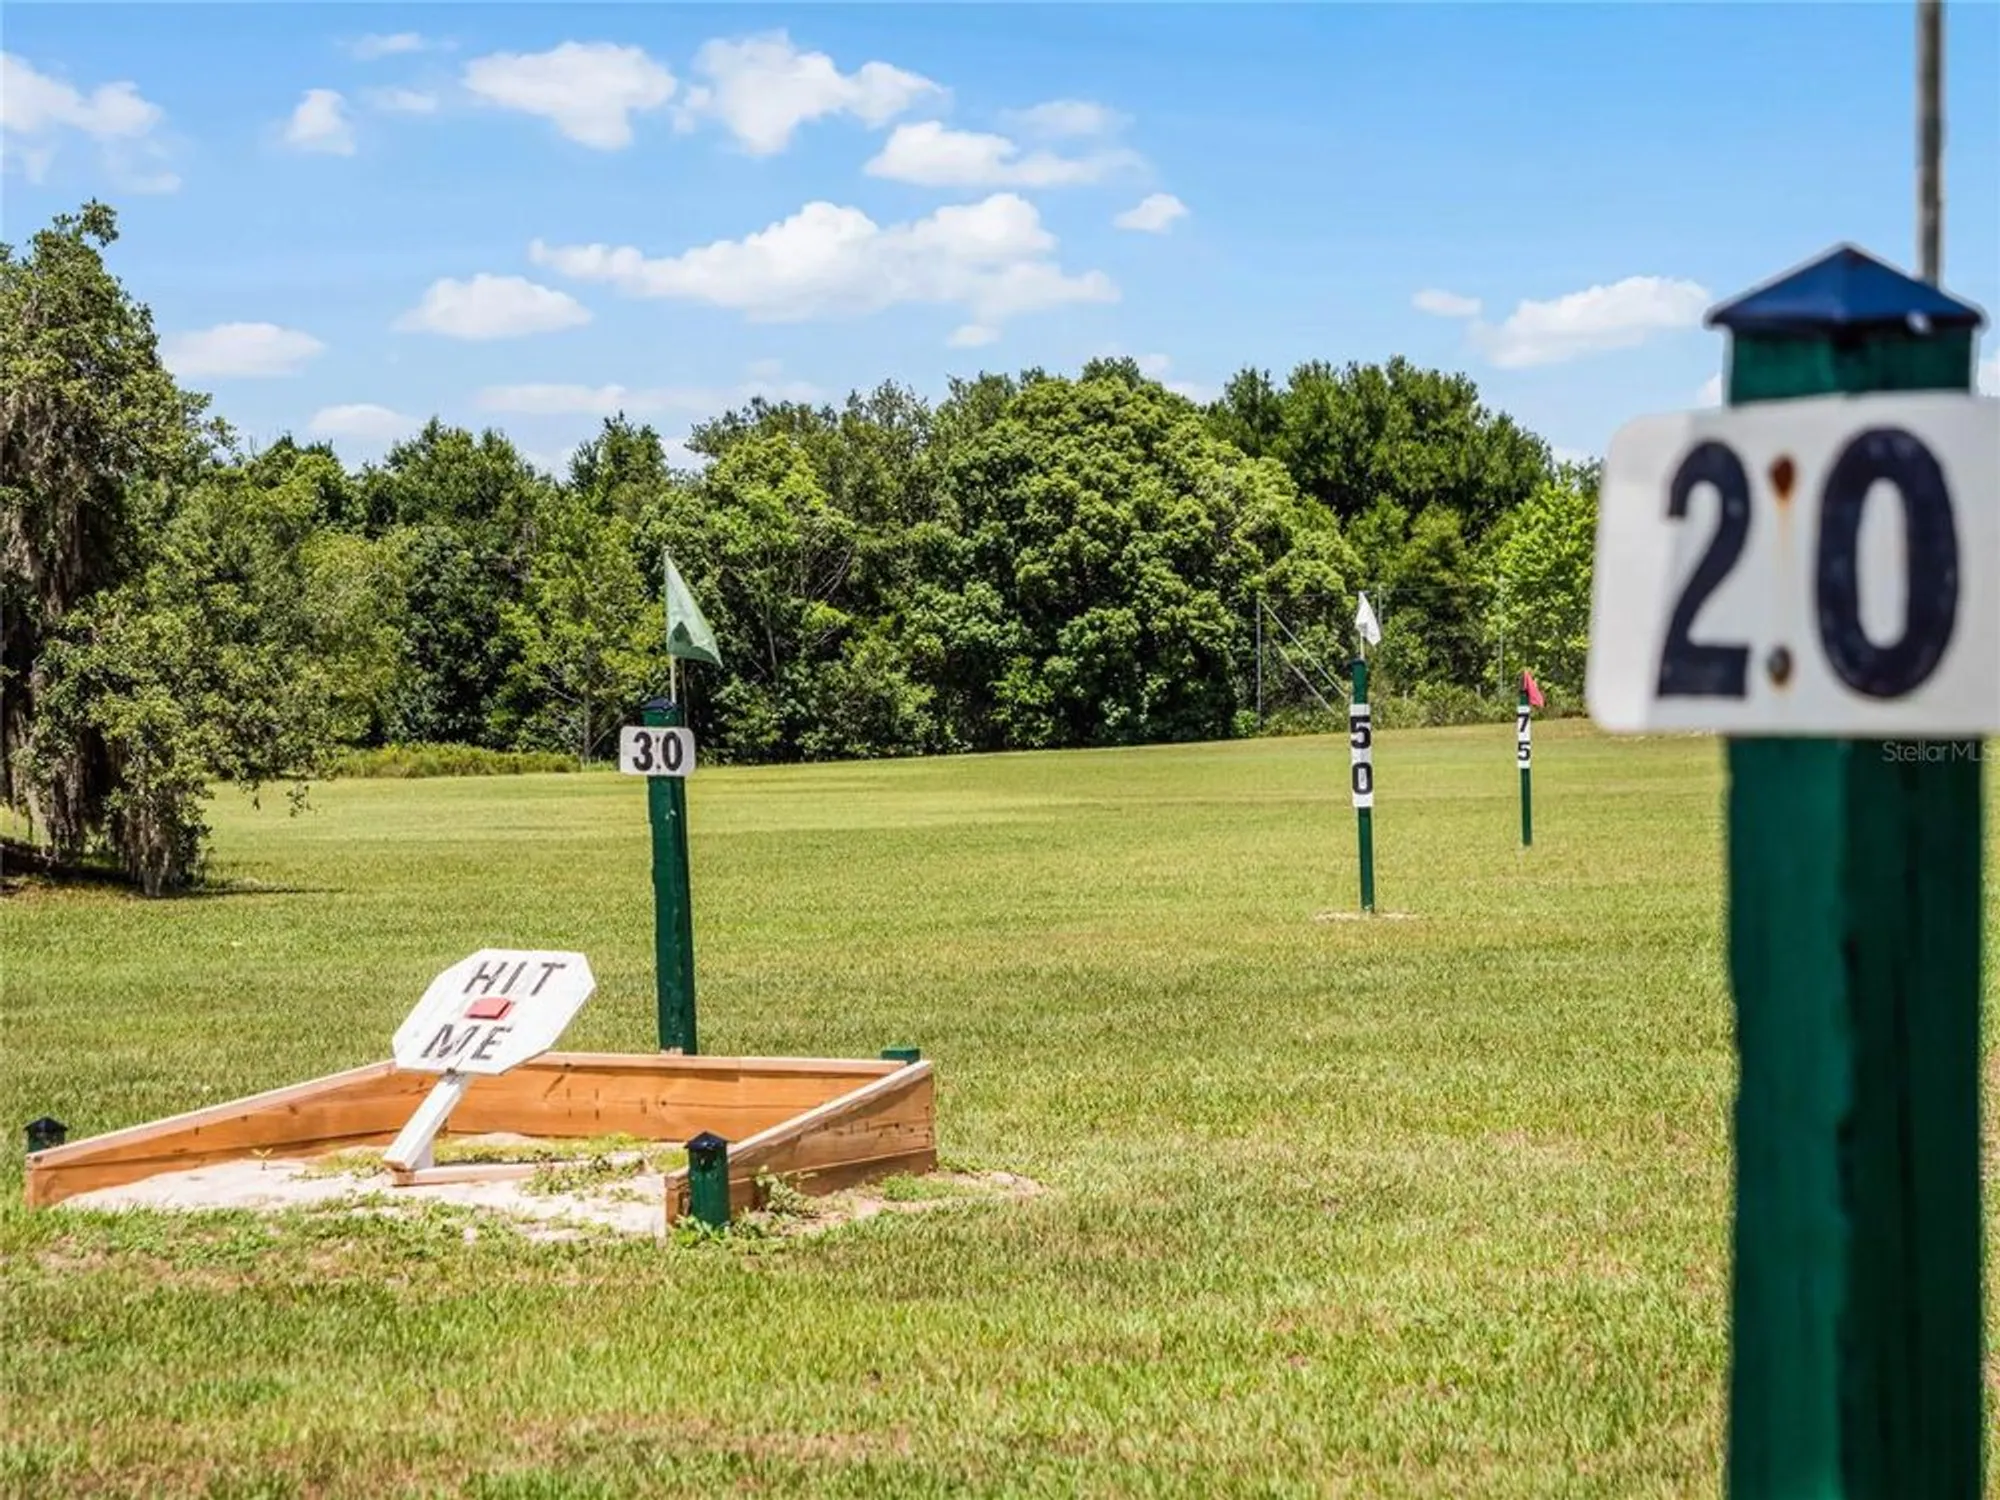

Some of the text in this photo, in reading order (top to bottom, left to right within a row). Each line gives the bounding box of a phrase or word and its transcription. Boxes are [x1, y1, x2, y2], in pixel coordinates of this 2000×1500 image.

[1656, 424, 1960, 703] 20
[632, 731, 683, 771] 30
[1350, 715, 1373, 795] 50
[1517, 712, 1531, 761] 75
[462, 961, 567, 997] HIT
[420, 1023, 514, 1061] ME
